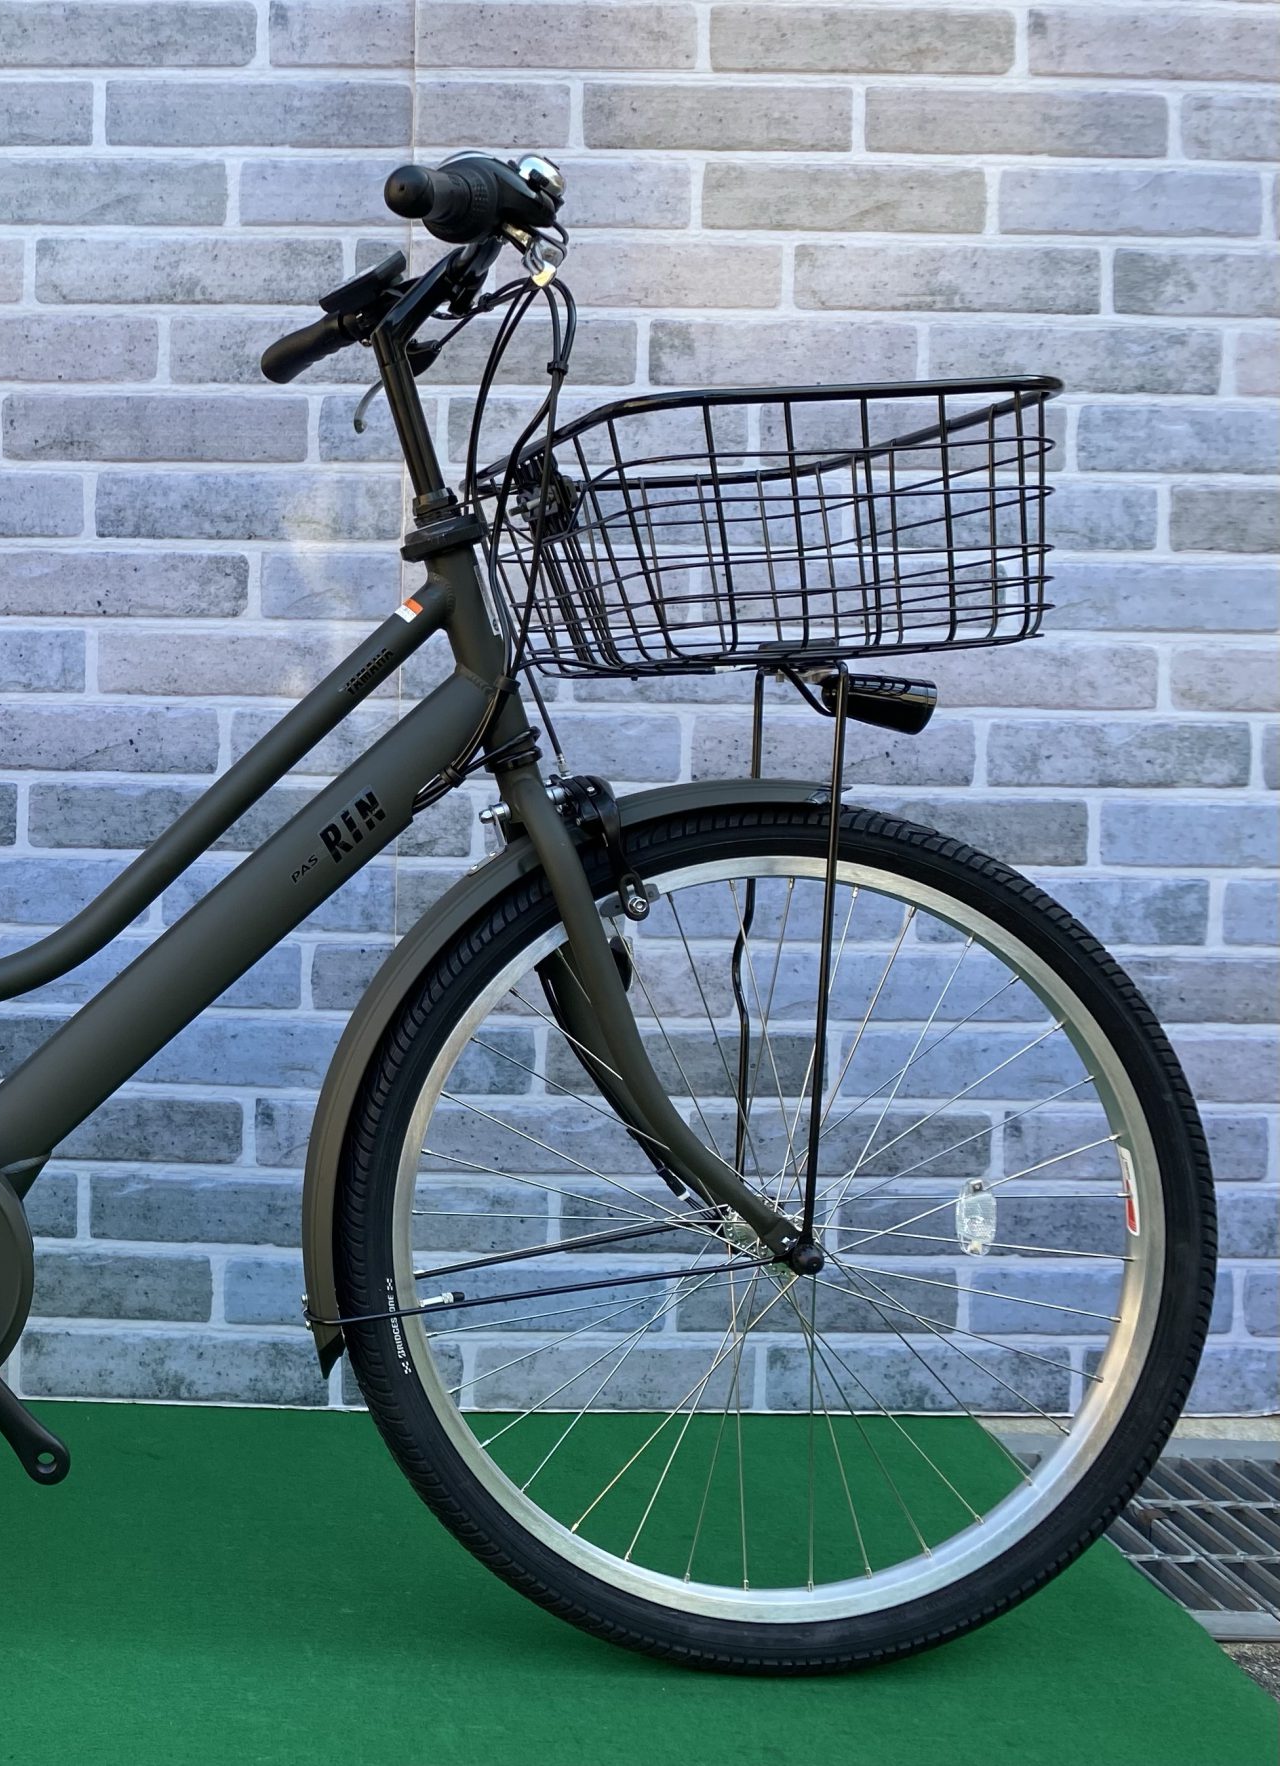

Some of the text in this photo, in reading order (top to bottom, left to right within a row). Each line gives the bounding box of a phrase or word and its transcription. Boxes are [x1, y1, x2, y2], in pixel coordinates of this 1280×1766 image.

[345, 648, 394, 695] YAMAHA
[290, 791, 387, 883] PAS RIN
[387, 1294, 407, 1359] BRIDGESONE
